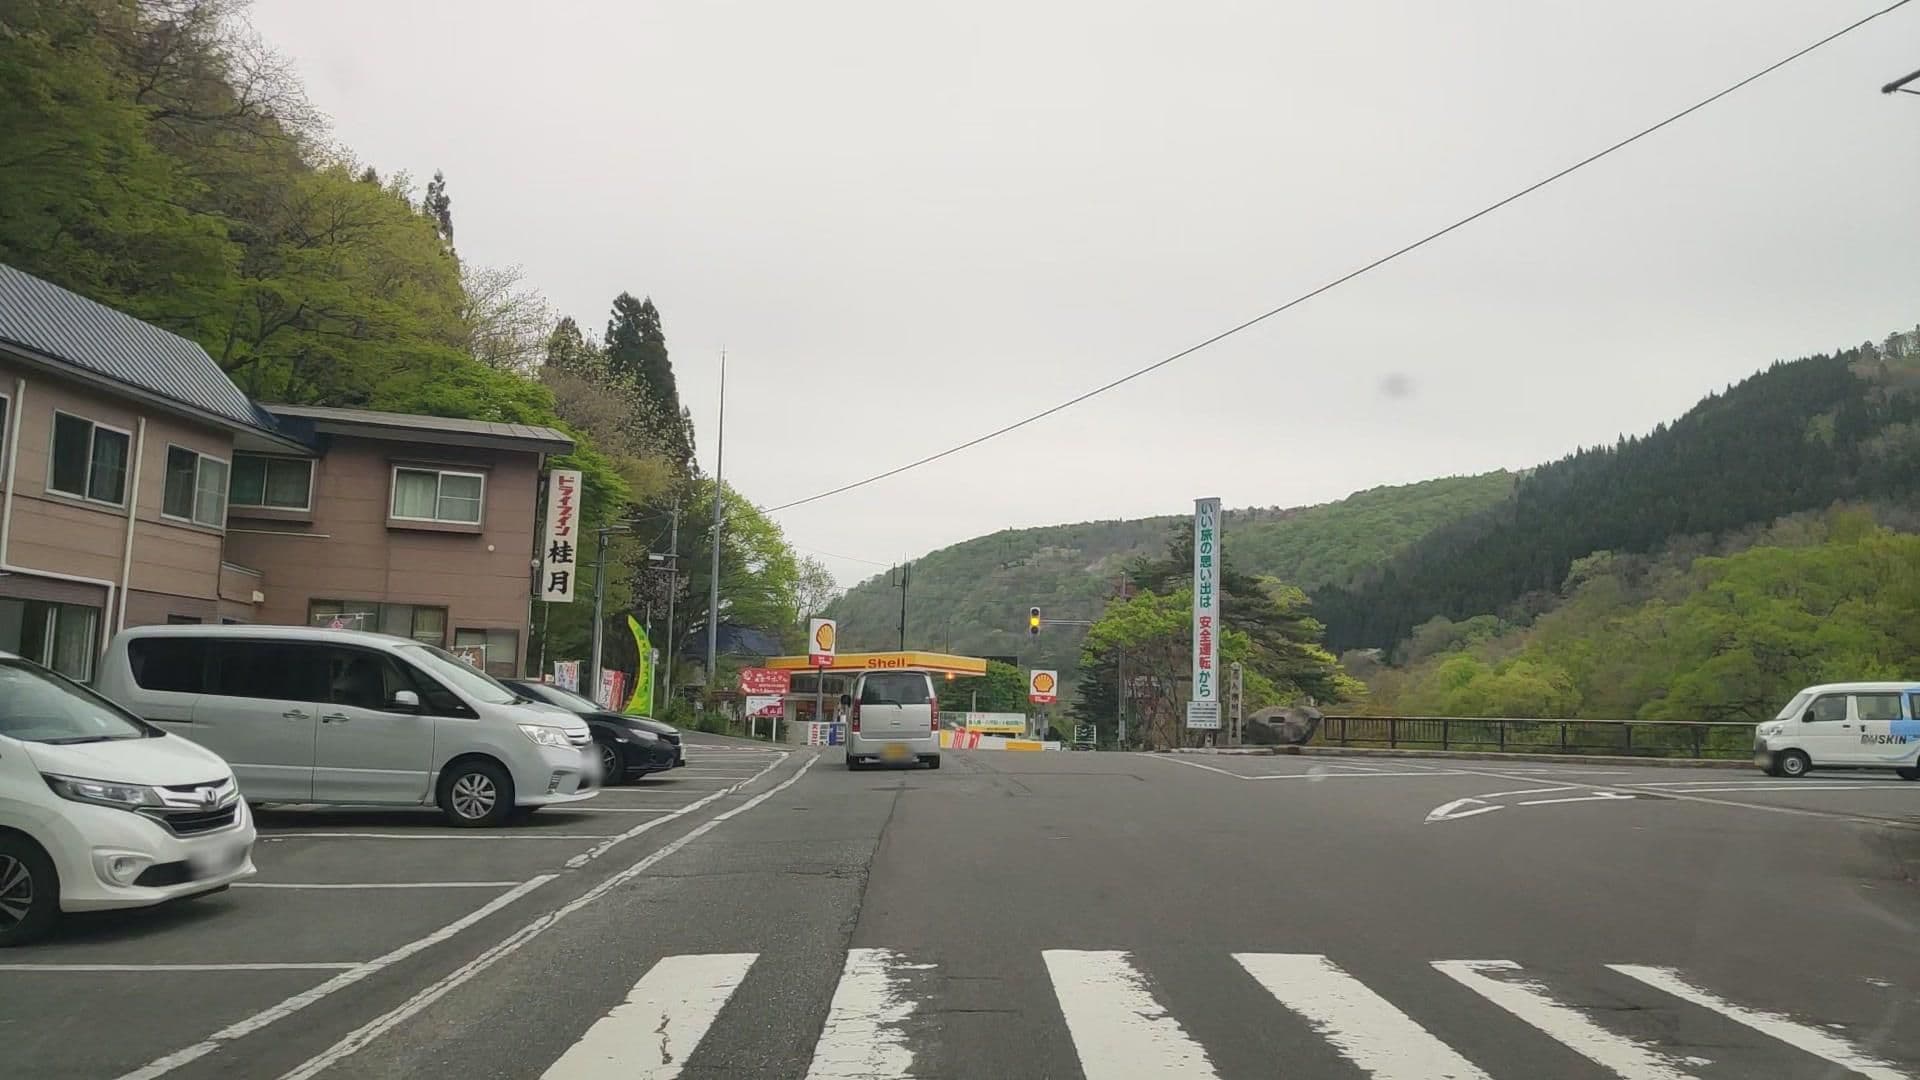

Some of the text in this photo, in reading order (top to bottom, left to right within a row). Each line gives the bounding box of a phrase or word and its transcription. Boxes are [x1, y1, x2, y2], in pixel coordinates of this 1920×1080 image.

[548, 475, 575, 594] ドライブイン 桂月
[1200, 502, 1213, 608] いい旅の思い出は
[867, 658, 906, 669] Shell
[1199, 616, 1212, 698] 安全運転から
